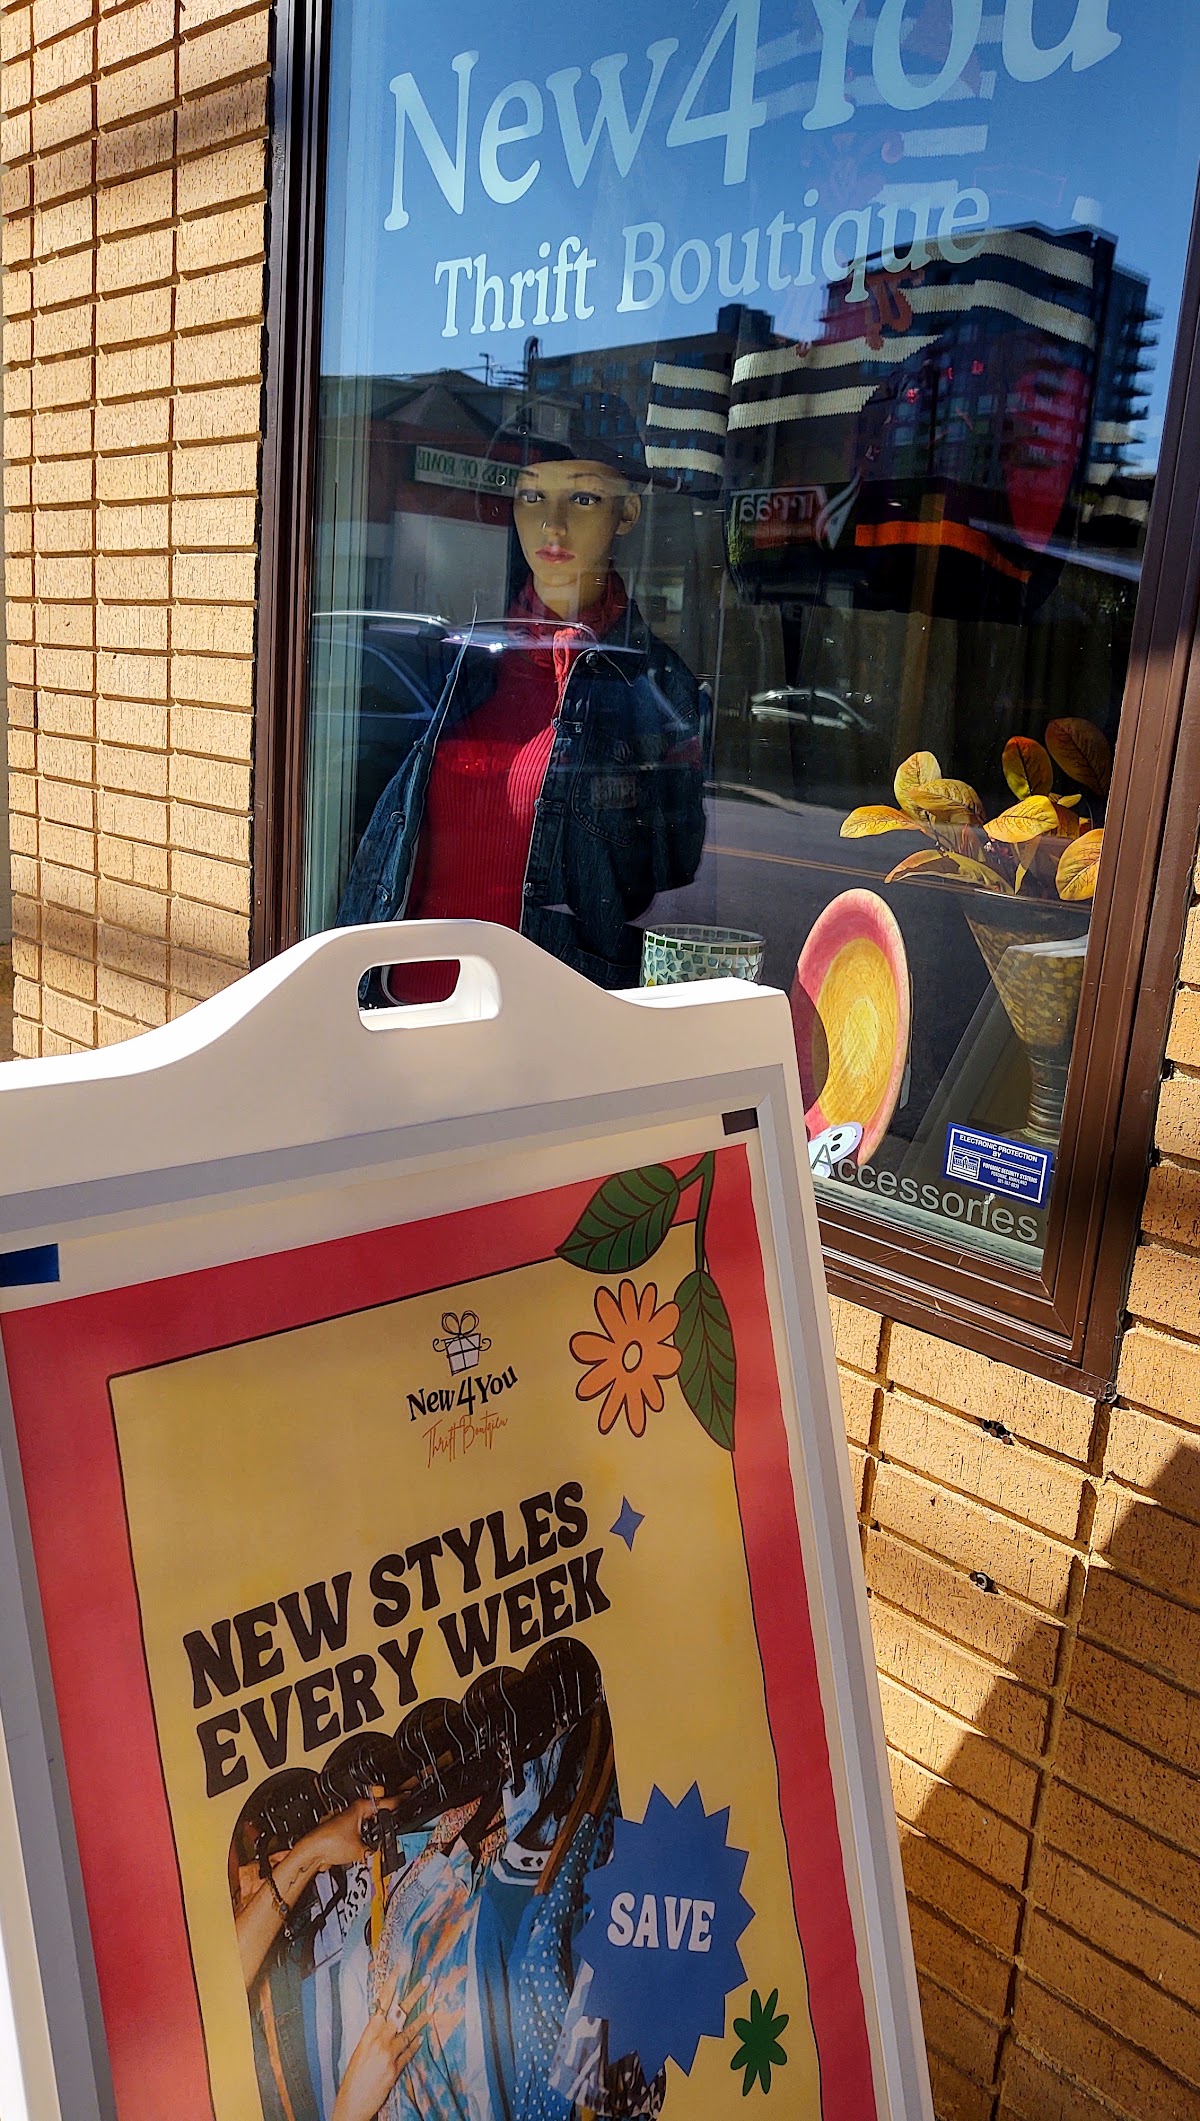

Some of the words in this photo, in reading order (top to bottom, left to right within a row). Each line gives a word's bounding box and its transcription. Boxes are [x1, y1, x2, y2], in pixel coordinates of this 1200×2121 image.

[433, 233, 598, 338] Thrift
[615, 184, 991, 314] Boutique
[959, 1134, 998, 1151] ELECTRONIC
[998, 1145, 1038, 1163] PROTECTION
[992, 1151, 1002, 1159] BY
[810, 1143, 1038, 1242] Accessories
[406, 1365, 519, 1422] New4You
[182, 1571, 352, 1709] NEW
[369, 1481, 588, 1628] STYLES
[196, 1628, 424, 1798] EVERY
[438, 1547, 611, 1678] WEEK
[607, 1892, 716, 1953] SAVE
